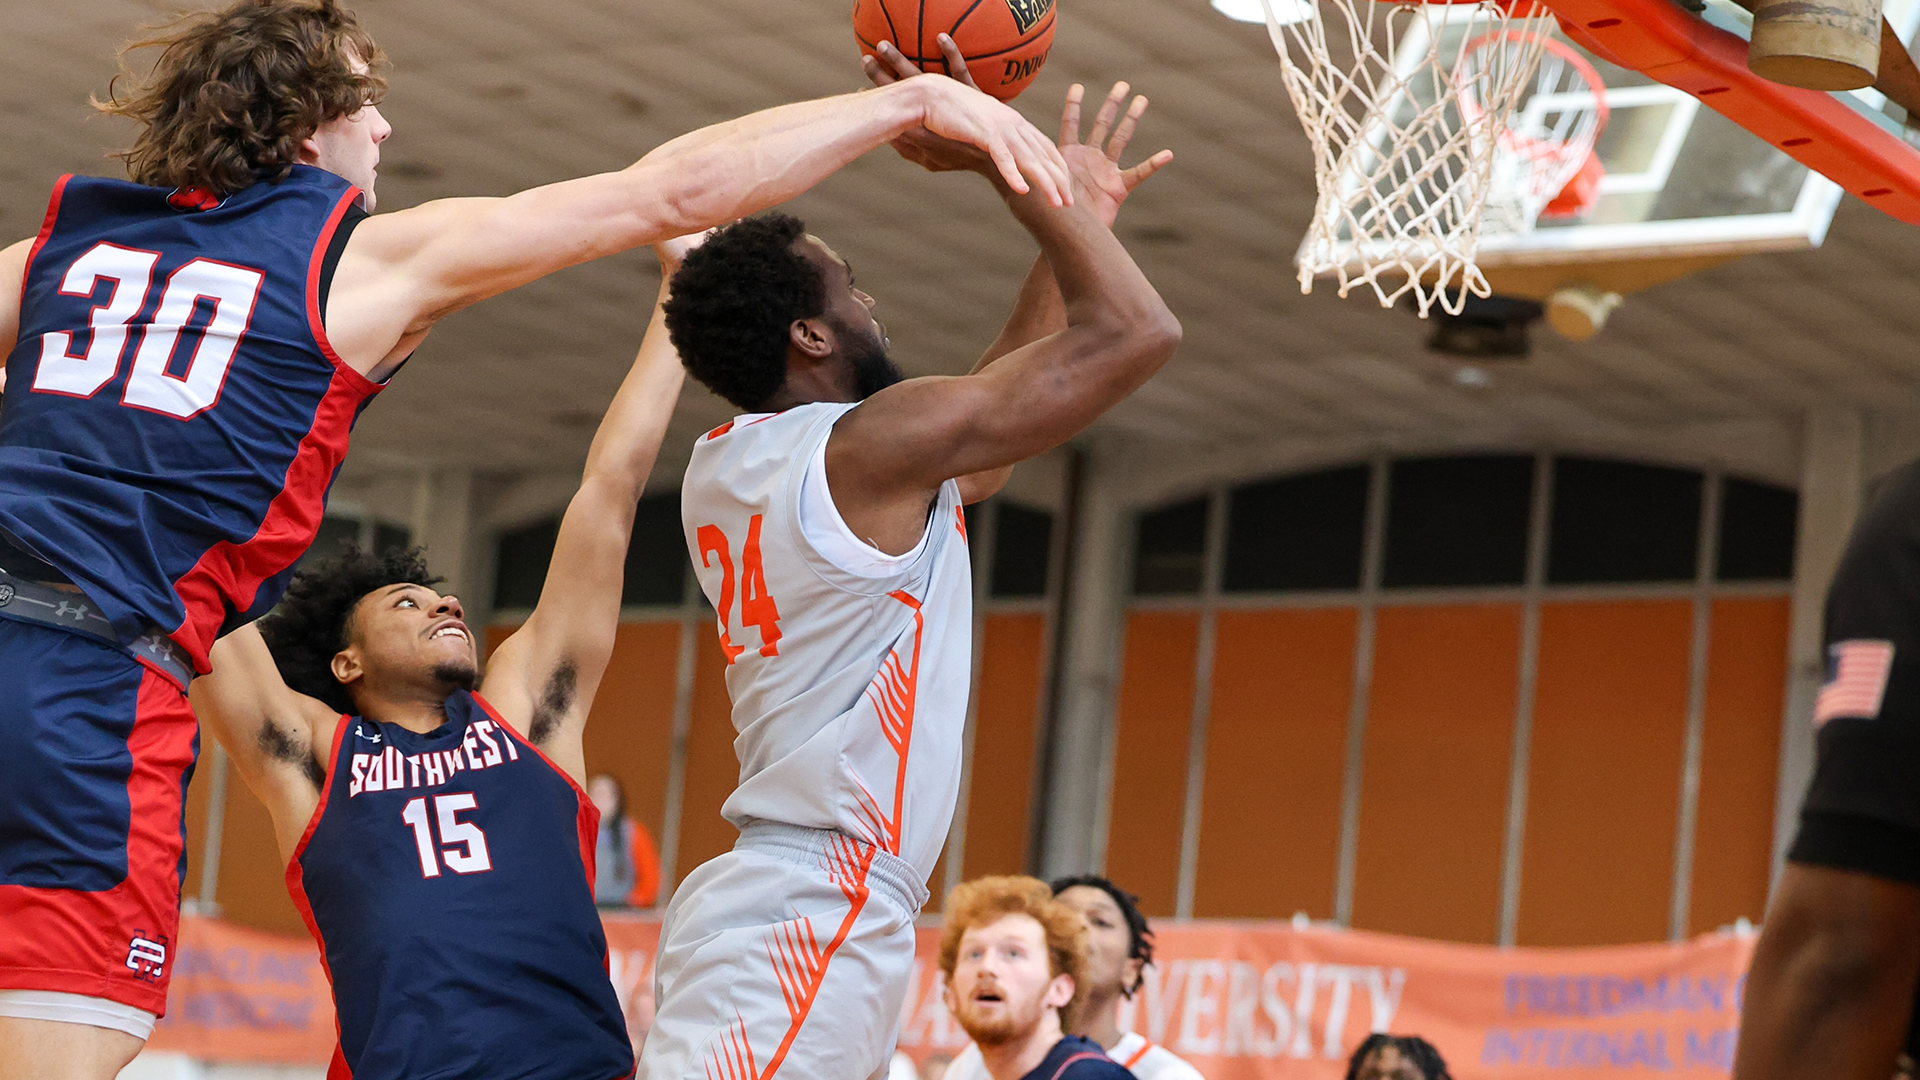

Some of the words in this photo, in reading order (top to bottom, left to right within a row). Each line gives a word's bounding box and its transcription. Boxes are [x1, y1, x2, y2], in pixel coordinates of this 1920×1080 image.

[30, 240, 265, 422] 30
[697, 514, 782, 665] 24
[350, 719, 519, 799] SOUTHWEST
[401, 791, 493, 879] 15
